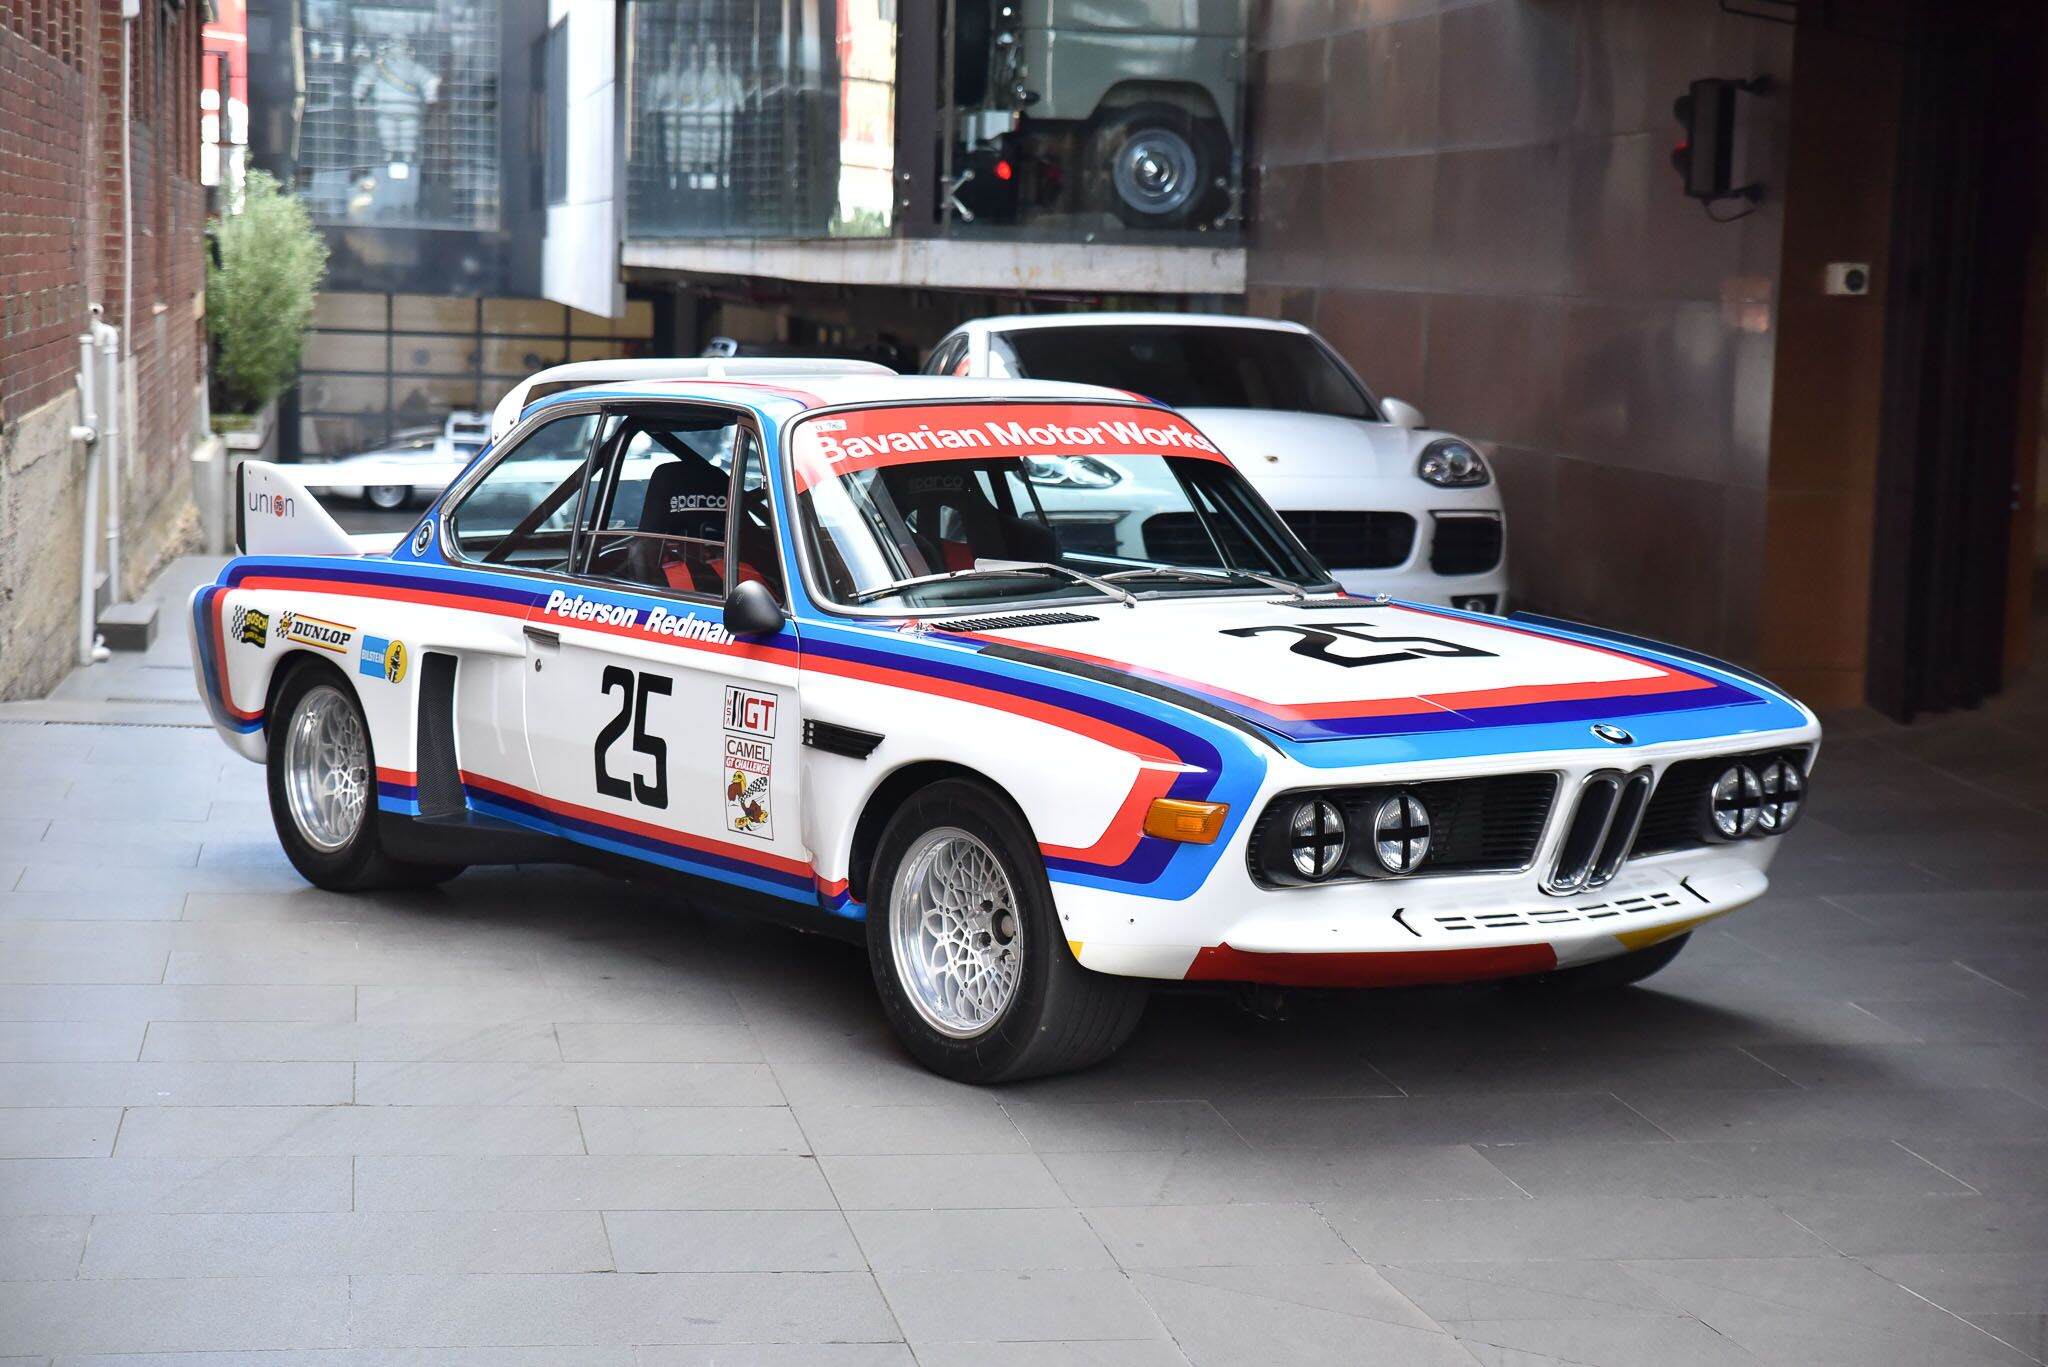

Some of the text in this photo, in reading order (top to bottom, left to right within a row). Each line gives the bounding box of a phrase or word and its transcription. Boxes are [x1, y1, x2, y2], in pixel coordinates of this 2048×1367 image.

[816, 420, 1219, 464] Bavarian Motor Works
[669, 494, 727, 511] sparco
[245, 612, 268, 629] BOSCH
[544, 589, 639, 629] Peterson
[293, 621, 351, 645] DUNLOP
[1218, 622, 1500, 668] 25
[744, 697, 775, 731] GT
[594, 664, 673, 810] 25
[727, 739, 770, 762] CAMEL
[726, 756, 770, 775] GT CHALLENGE
